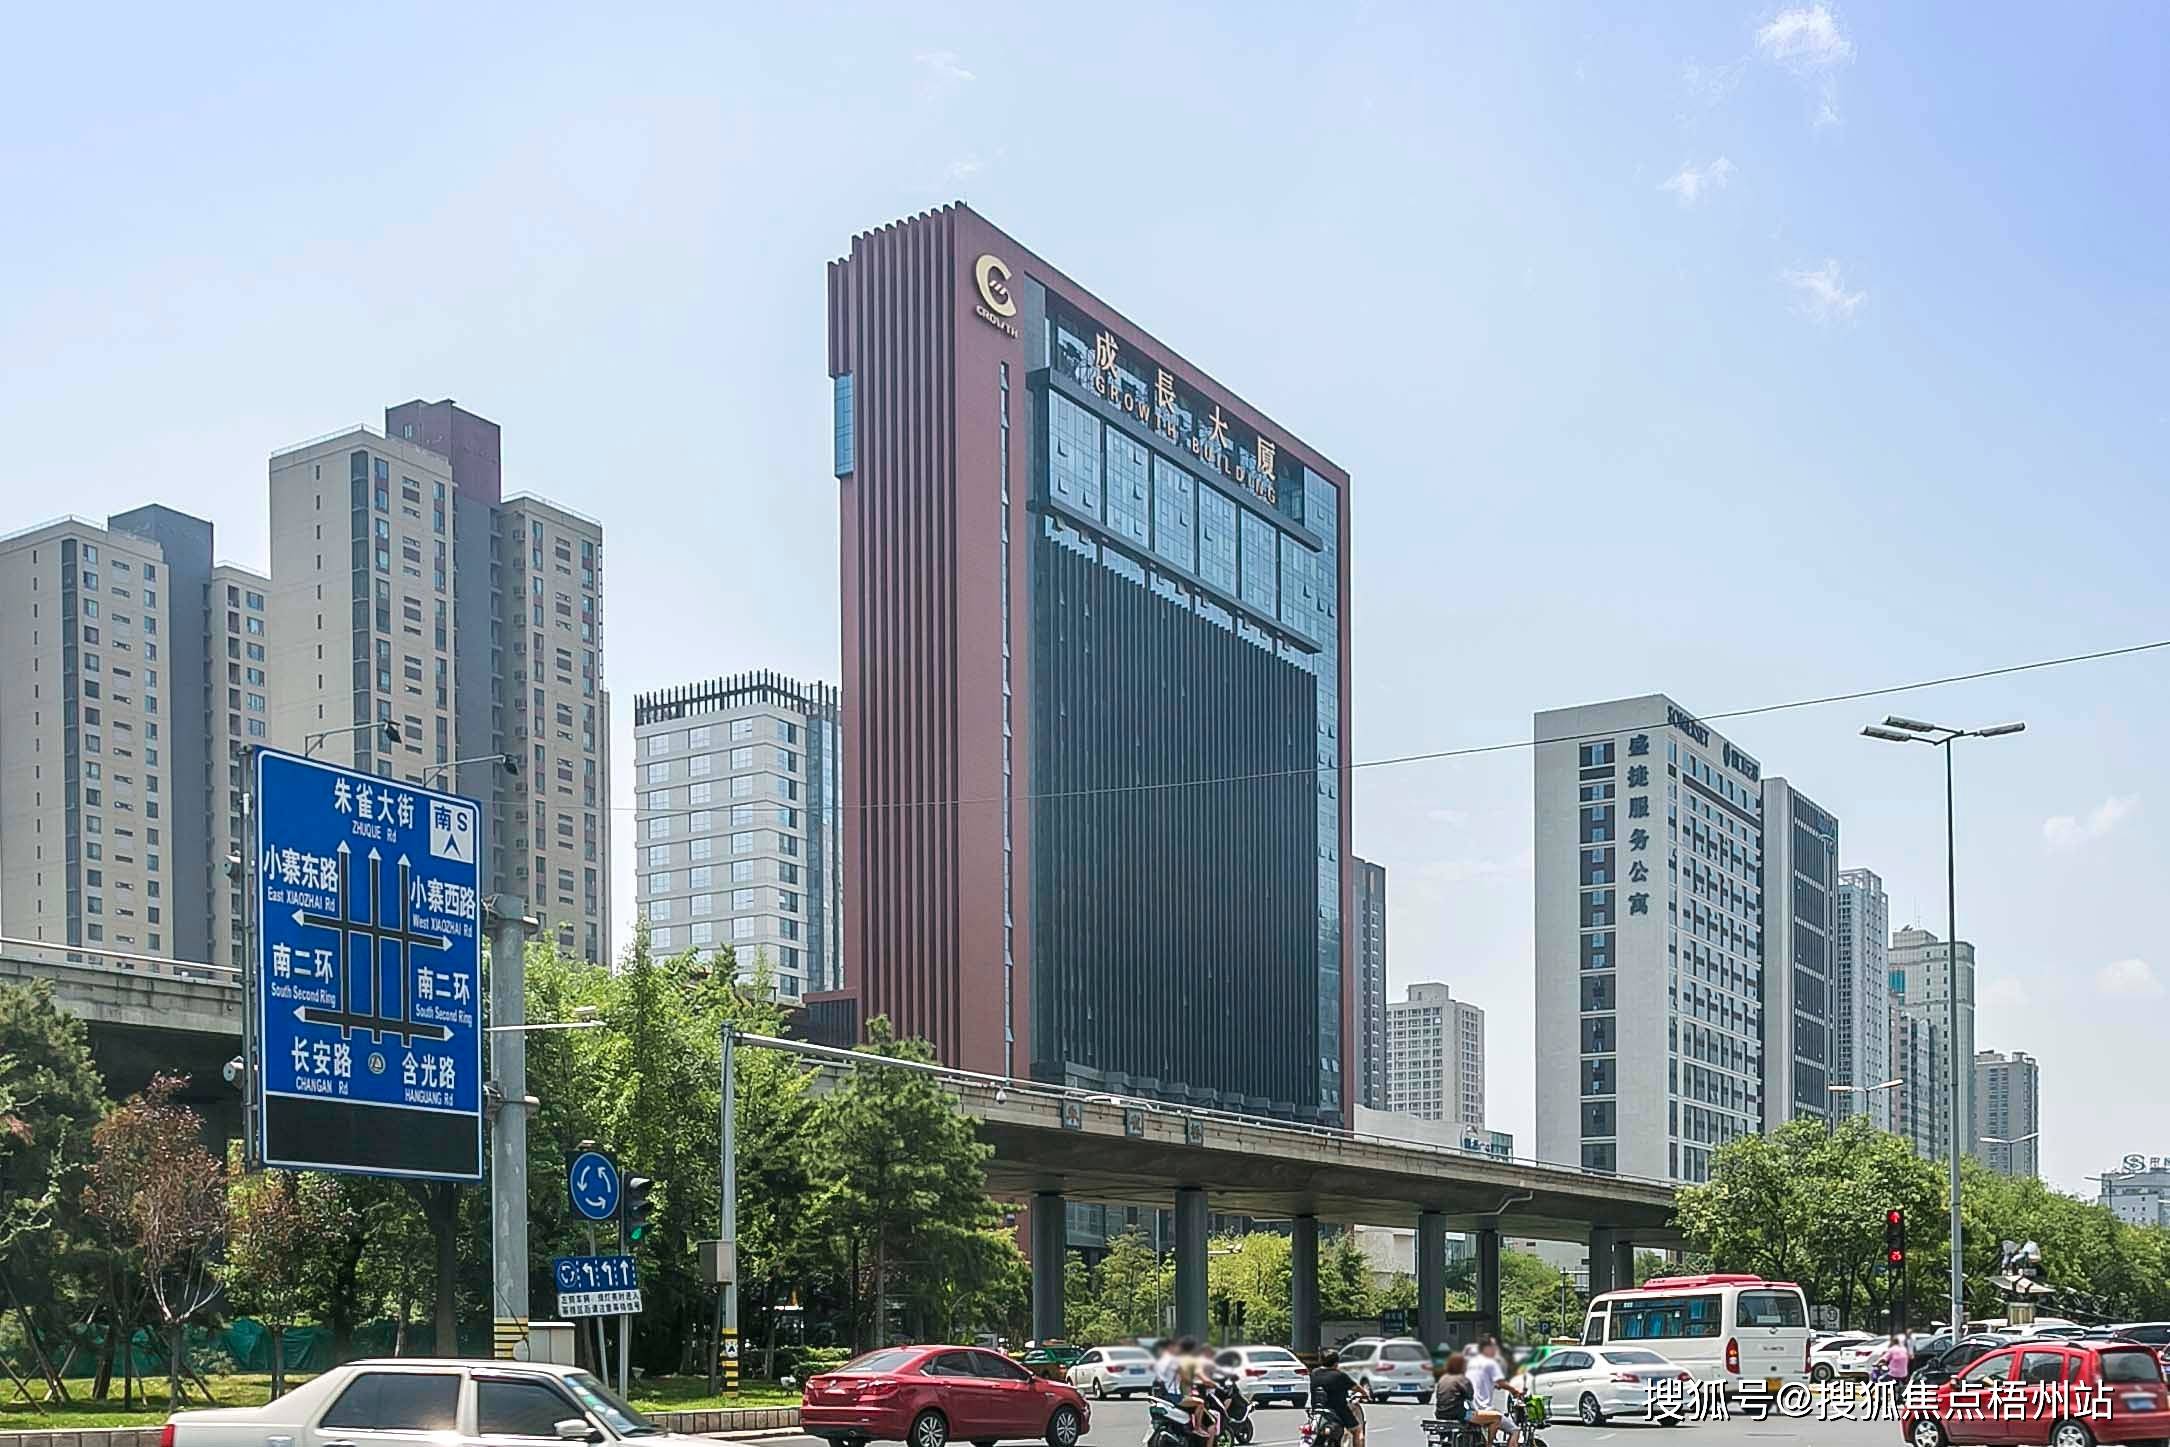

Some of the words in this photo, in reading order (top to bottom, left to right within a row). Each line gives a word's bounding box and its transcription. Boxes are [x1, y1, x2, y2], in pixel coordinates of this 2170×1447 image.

[1095, 375, 1177, 440] GROWTH
[1191, 434, 1277, 504] BUILDING
[334, 777, 414, 830] 朱雀大街
[434, 806, 452, 832] 南
[457, 811, 468, 832] S
[352, 820, 382, 840] ZHUQUE
[386, 827, 397, 843] Rd
[1627, 733, 1650, 917] 盛捷服务公寓
[263, 844, 339, 893] 小寨东路
[267, 886, 285, 902] East
[286, 890, 323, 908] XIAOZHAI
[324, 897, 336, 912] Rd
[410, 875, 476, 921] 小寨西路
[412, 913, 430, 930] West
[431, 916, 462, 935] XIAOZHAI
[463, 922, 473, 937] Rd
[272, 942, 334, 985] 南二环
[271, 981, 292, 998] South
[292, 985, 319, 1005] Second
[319, 988, 336, 1009] Ring
[416, 966, 471, 1006] 南二环
[415, 1003, 434, 1019] South
[435, 1005, 458, 1023] Second
[458, 1008, 473, 1028] Ring
[291, 1036, 352, 1078] 长安路
[402, 1052, 456, 1089] 含光路
[296, 1076, 333, 1093] CHANGAN
[338, 1080, 349, 1096] Rd
[404, 1089, 442, 1105] HANGUANG
[444, 1093, 454, 1106] Rd
